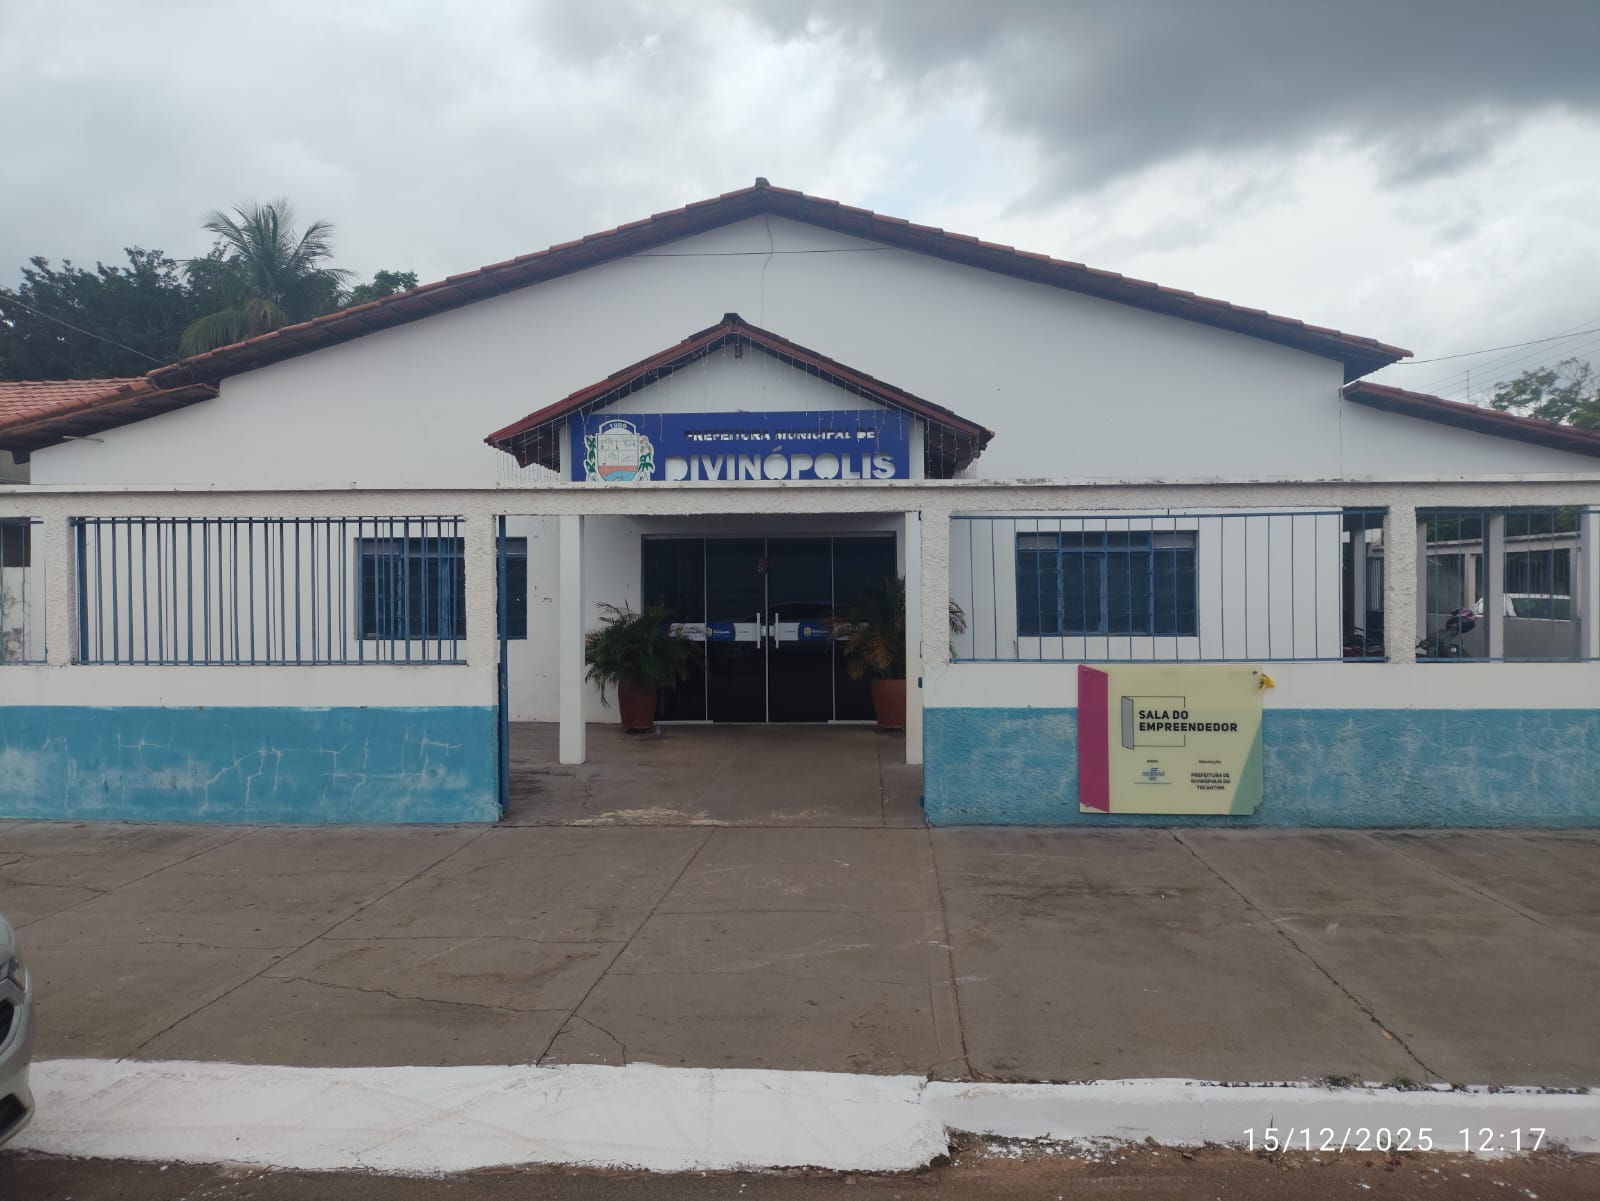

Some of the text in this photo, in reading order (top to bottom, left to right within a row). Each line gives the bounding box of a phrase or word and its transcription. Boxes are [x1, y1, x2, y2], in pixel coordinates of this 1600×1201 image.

[775, 428, 852, 441] MUNICIPAL
[856, 427, 876, 439] DE
[664, 445, 896, 481] DIVINÓPOLIS
[1138, 709, 1189, 720] SALA DO
[1138, 722, 1238, 732] EMPREENDEDOR
